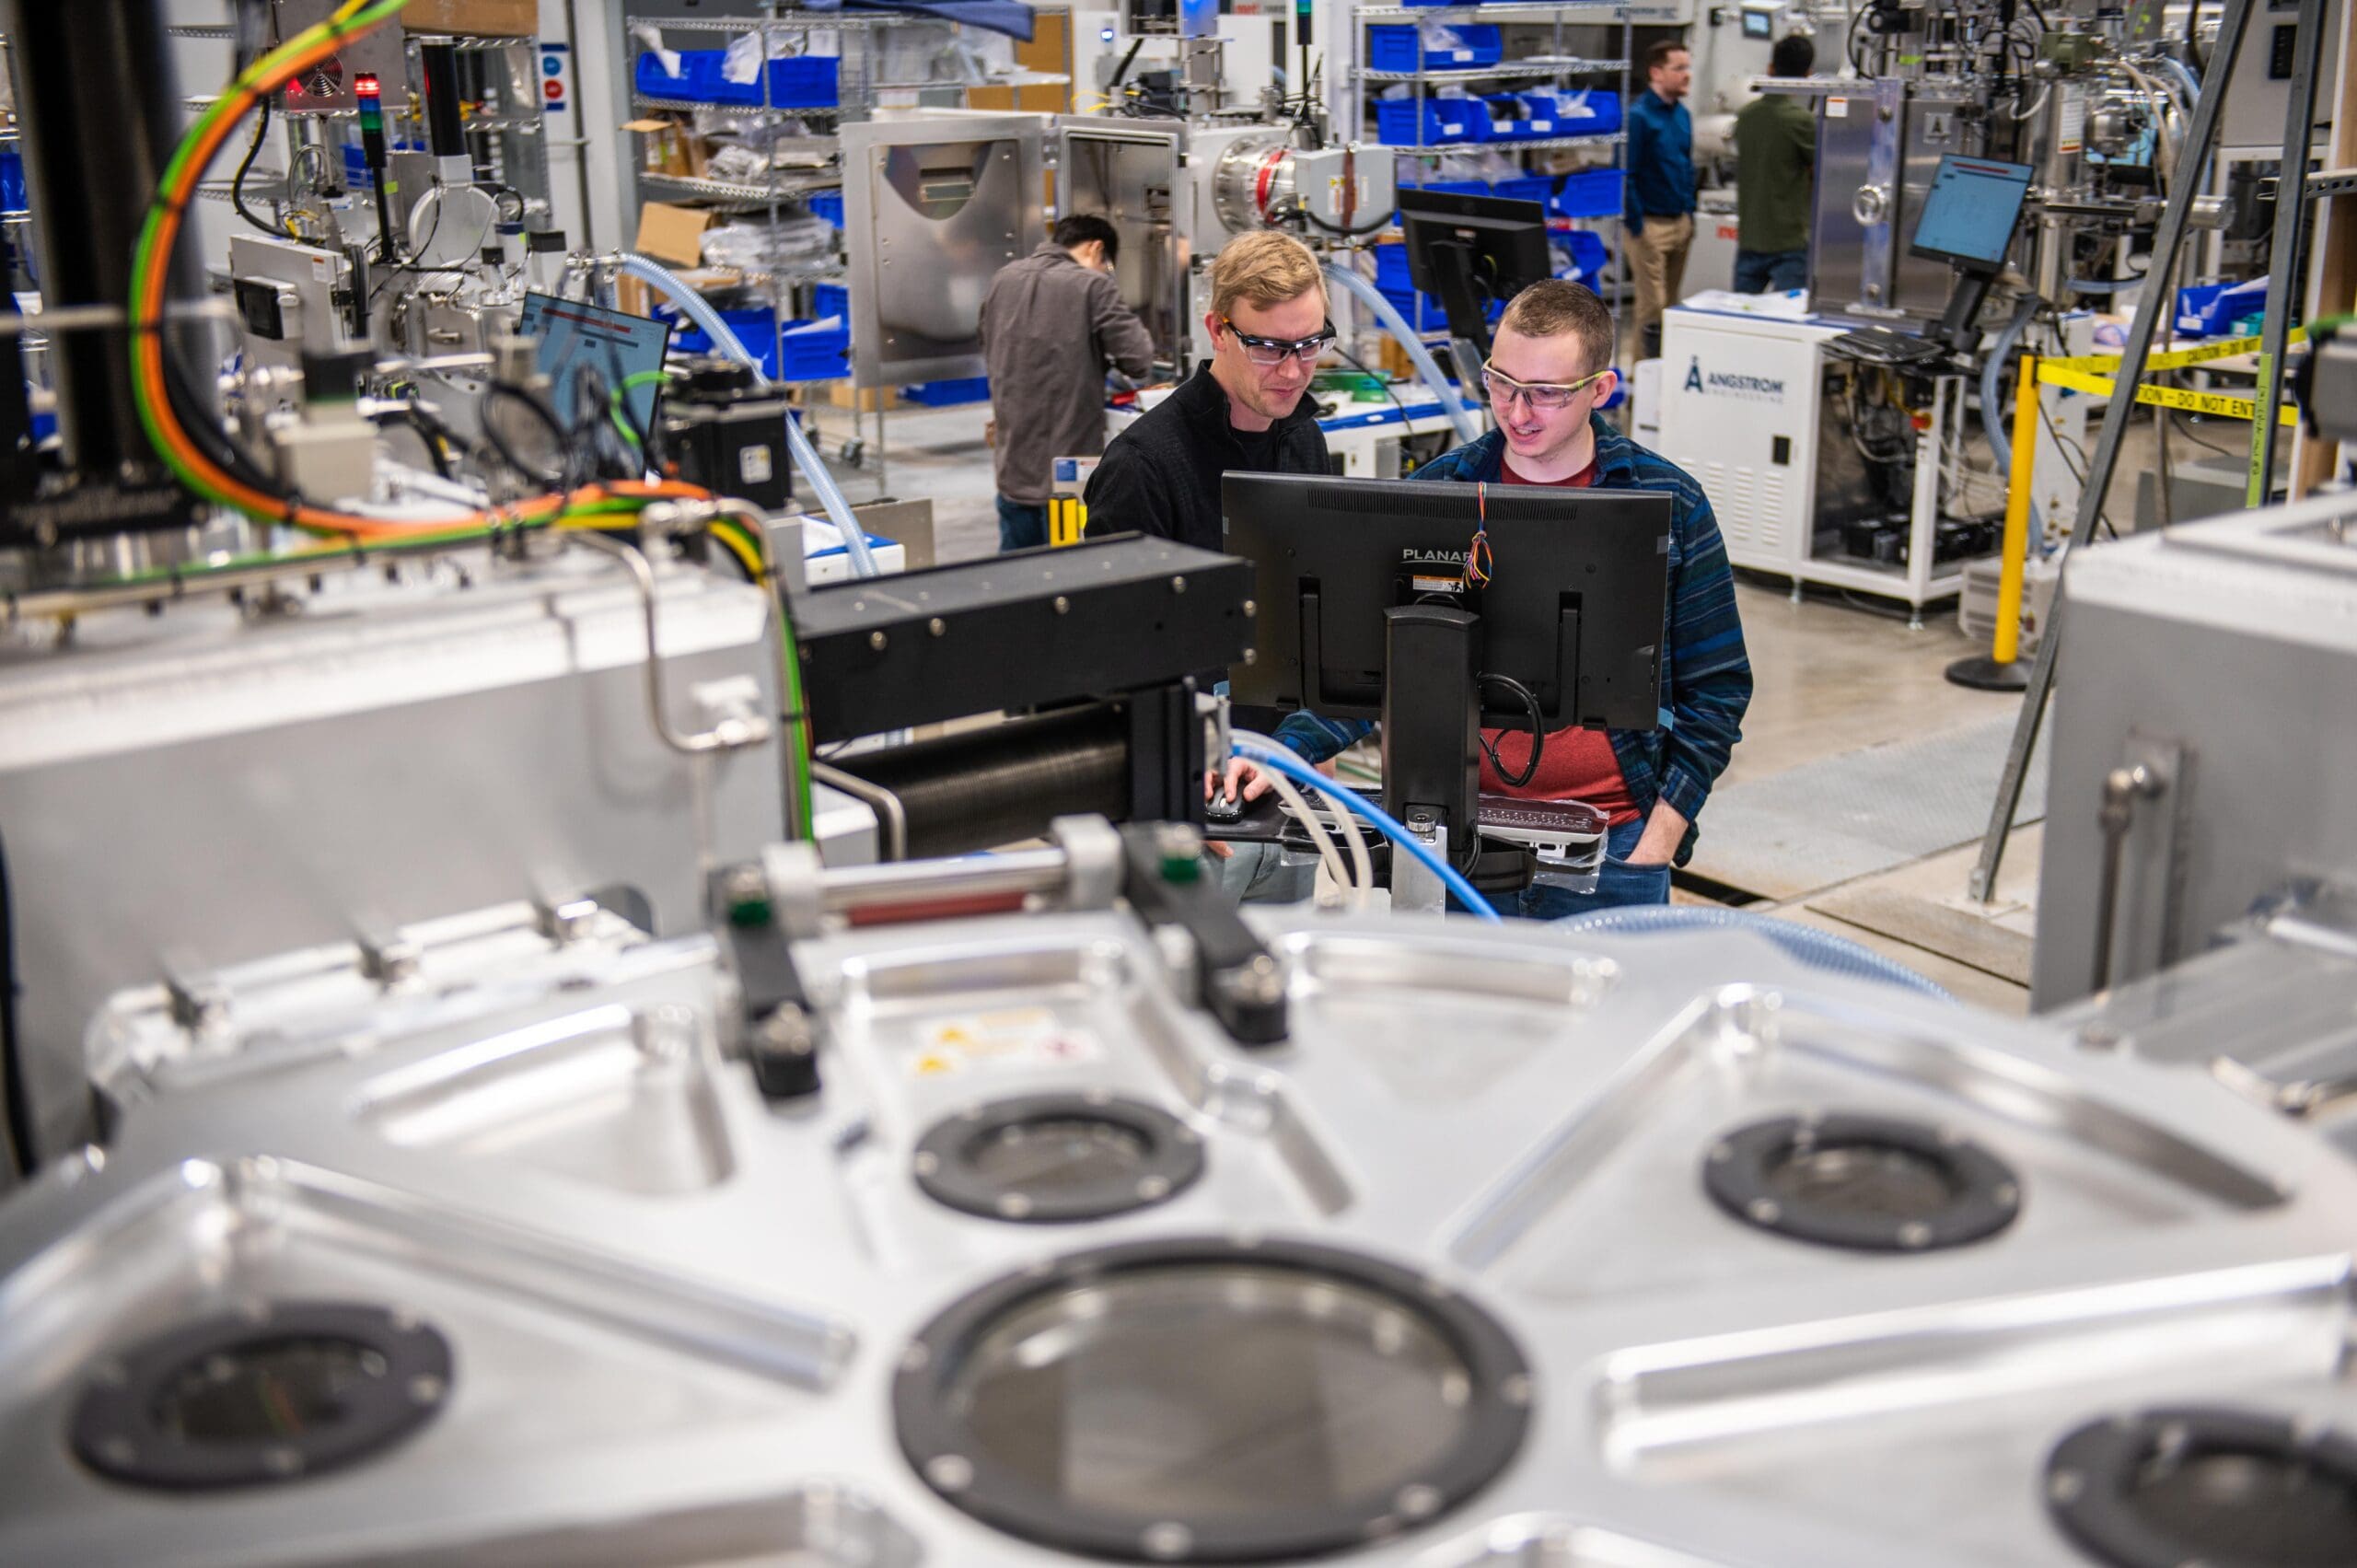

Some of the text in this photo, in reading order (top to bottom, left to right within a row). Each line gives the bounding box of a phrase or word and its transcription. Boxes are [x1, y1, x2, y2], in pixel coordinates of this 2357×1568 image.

[1708, 372, 1784, 393] ANGSTROM
[2178, 392, 2195, 407] DO
[2201, 396, 2226, 411] NOT
